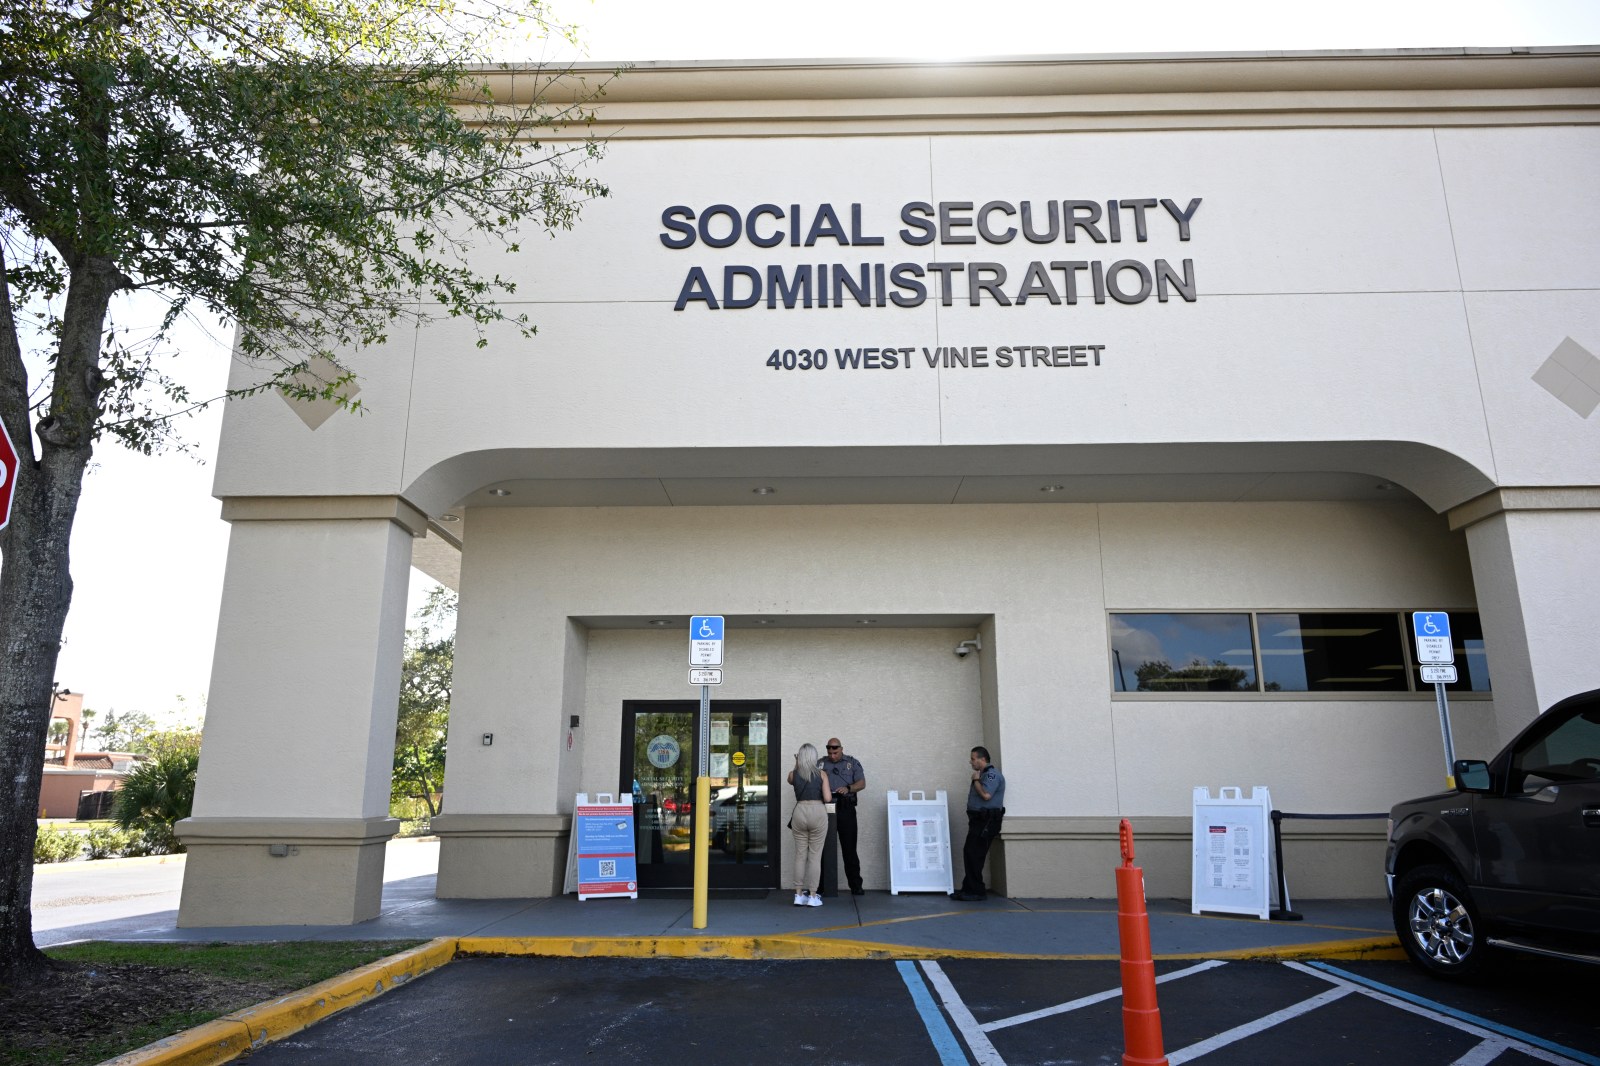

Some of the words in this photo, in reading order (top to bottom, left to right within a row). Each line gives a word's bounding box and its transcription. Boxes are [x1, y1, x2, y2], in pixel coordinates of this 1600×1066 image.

[659, 203, 885, 249] SOCIAL
[899, 198, 1203, 246] SECURITY
[674, 259, 1197, 311] ADMINISTRATION
[766, 348, 828, 370] 4030
[835, 347, 915, 369] WEST
[922, 346, 989, 368] VINE
[995, 344, 1106, 368] STREET
